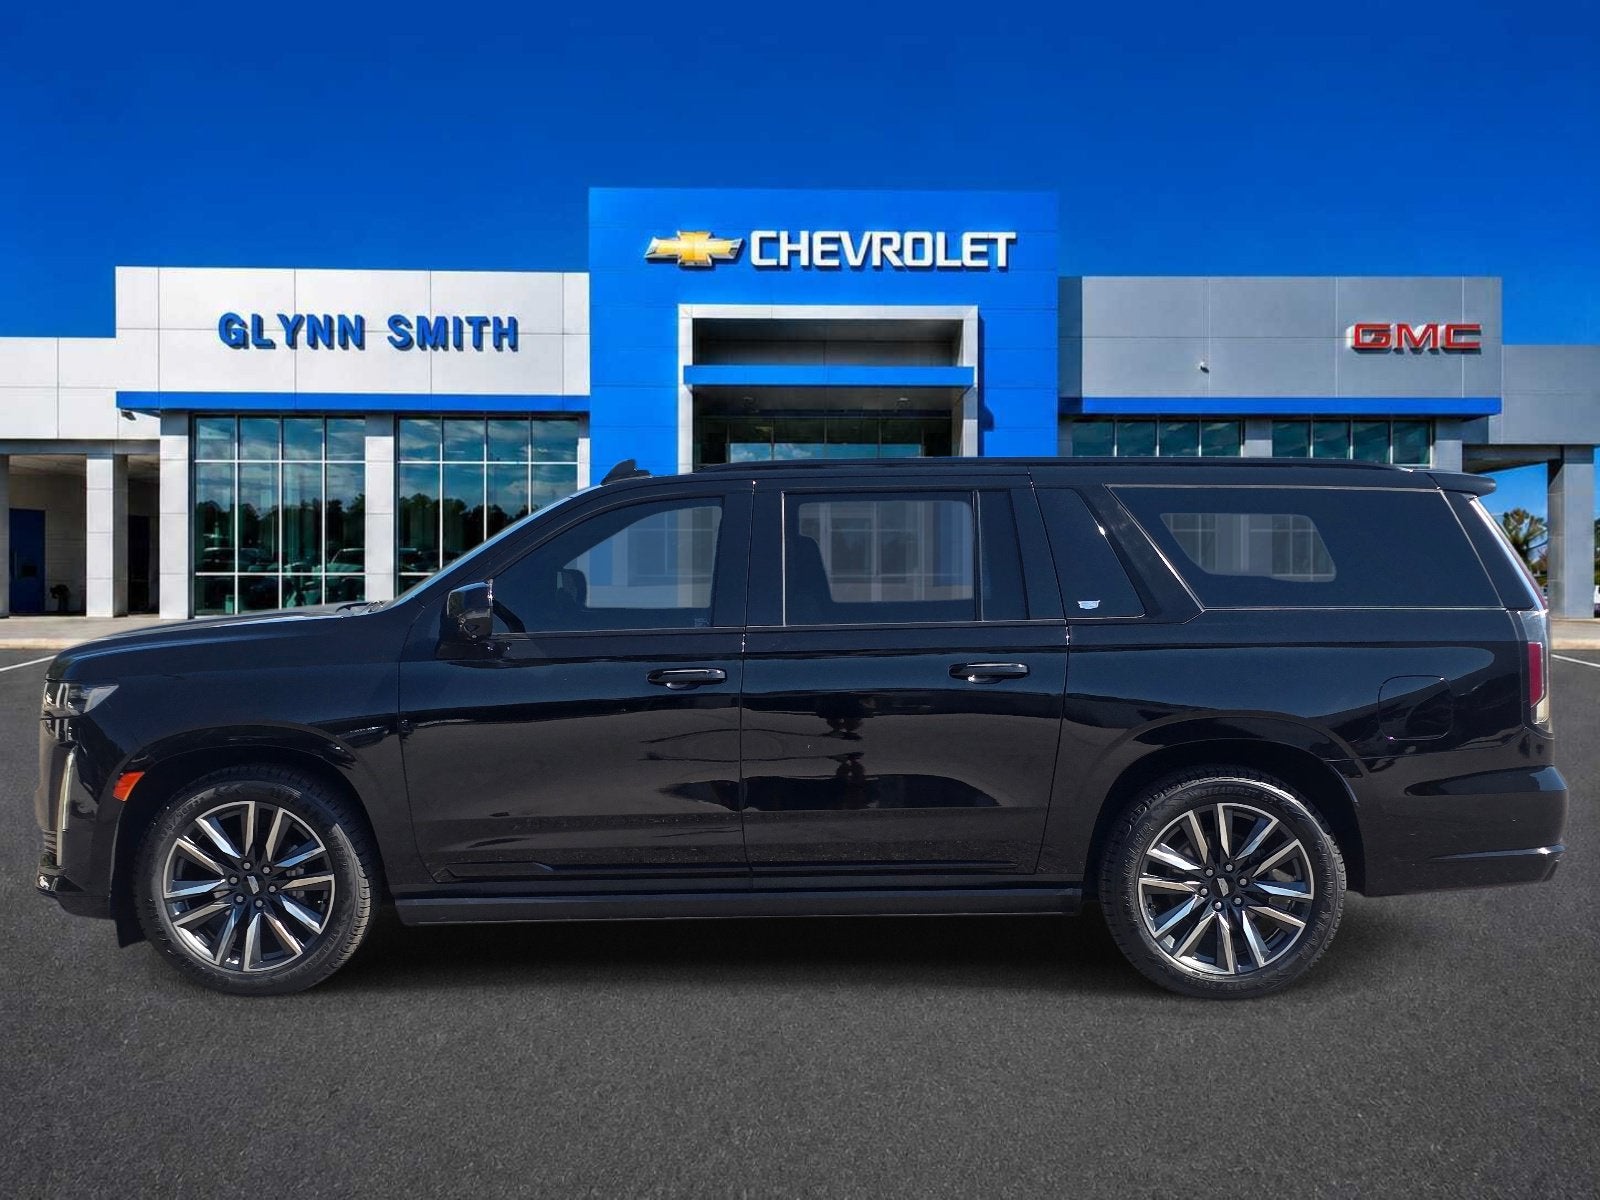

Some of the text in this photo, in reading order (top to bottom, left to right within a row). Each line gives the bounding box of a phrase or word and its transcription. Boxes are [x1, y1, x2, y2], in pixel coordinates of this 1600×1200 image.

[750, 229, 1017, 270] CHEVROLET
[218, 312, 518, 351] GLYNN SMITH
[1350, 322, 1482, 353] GMC
